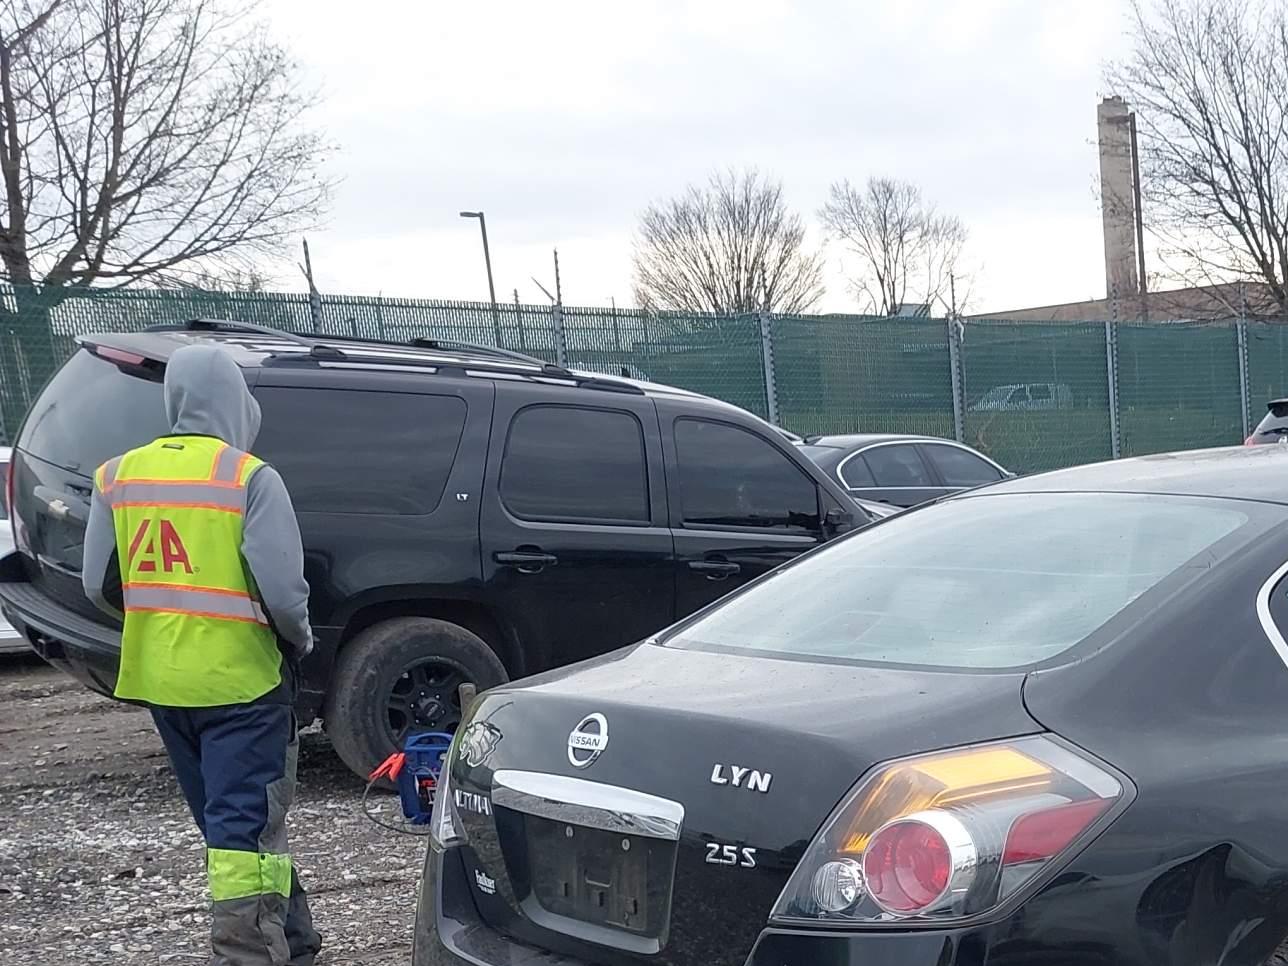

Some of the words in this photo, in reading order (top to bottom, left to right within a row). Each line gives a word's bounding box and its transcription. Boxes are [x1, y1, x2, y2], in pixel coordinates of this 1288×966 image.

[456, 493, 469, 501] LT
[570, 735, 601, 747] NISSAN
[711, 764, 771, 793] LYN
